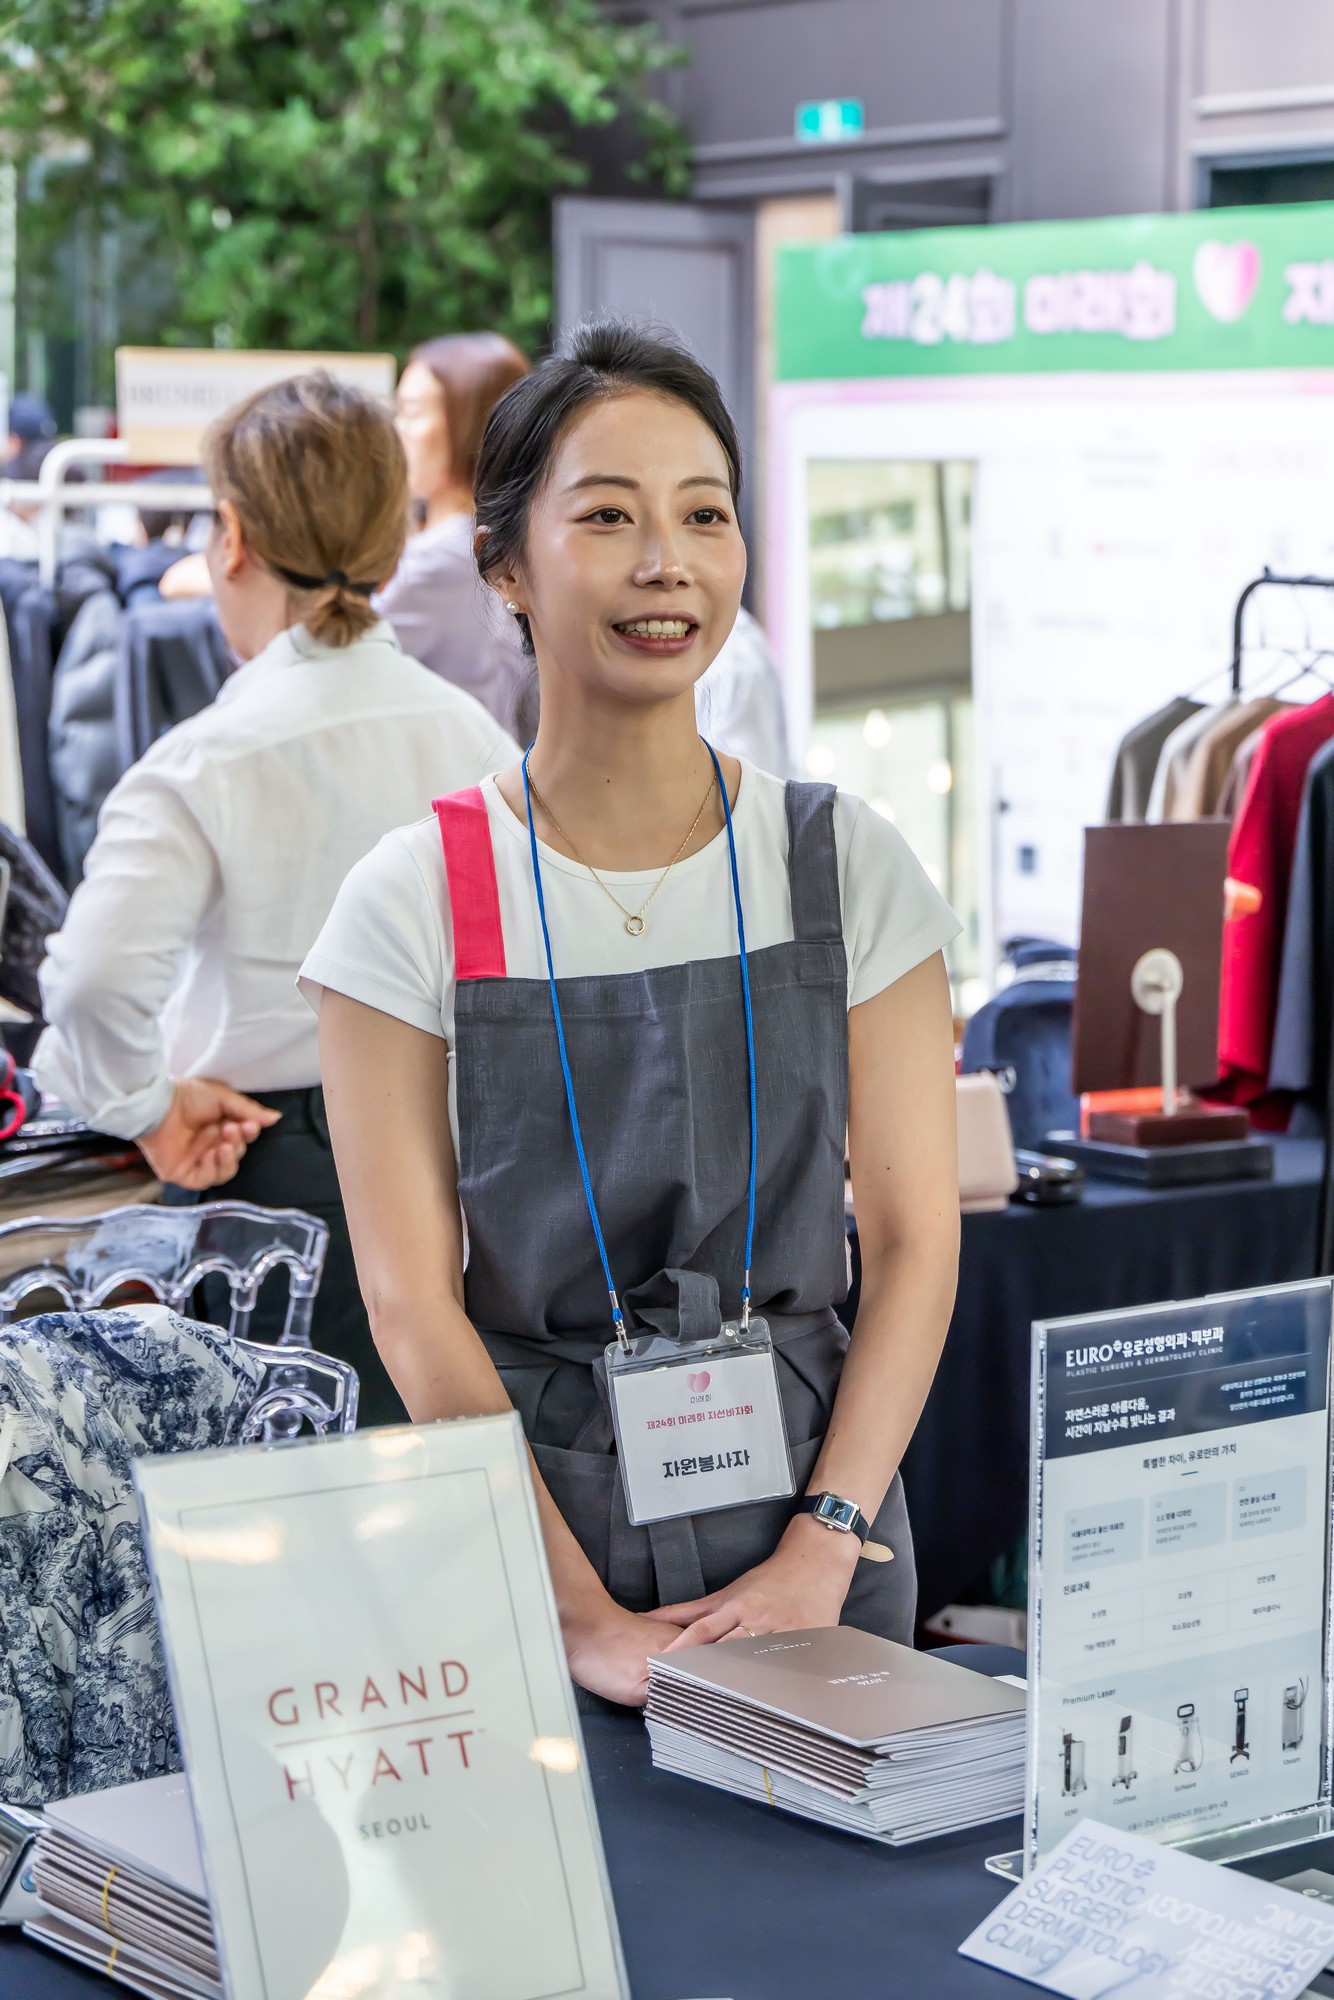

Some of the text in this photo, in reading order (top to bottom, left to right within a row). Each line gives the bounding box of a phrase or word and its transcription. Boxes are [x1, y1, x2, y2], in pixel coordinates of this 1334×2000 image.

[1066, 1344, 1113, 1367] EURO
[1066, 1367, 1098, 1378] PLASTIC
[1100, 1361, 1134, 1373] SURGERY
[1144, 1351, 1197, 1366] DERMATOLOGY
[1198, 1346, 1224, 1356] CLINIC
[690, 1395, 712, 1404] 미래회
[1064, 1397, 1149, 1423] 자연스러운 아름다움,
[646, 1417, 676, 1430] 제24회
[678, 1412, 705, 1425] 미래회
[1064, 1408, 1176, 1439] 시간이 지날수록 빛나는 결과
[662, 1449, 751, 1479] 자원봉사자
[1143, 1442, 1237, 1469] 특별한 차이, 유로만의 가치
[1063, 1581, 1090, 1595] 진료과목
[268, 1660, 469, 1726] GRAND
[1062, 1689, 1116, 1705] Premium Laser
[283, 1730, 474, 1802] HYATT
[359, 1813, 431, 1840] SEOUL
[1067, 1835, 1134, 1872] EURO
[1045, 1857, 1146, 1906] PLASTIC
[1026, 1879, 1139, 1931] SURGERY
[985, 1923, 1063, 1965] CLINIC
[1004, 1900, 1178, 1977] DERMATOLOGY
